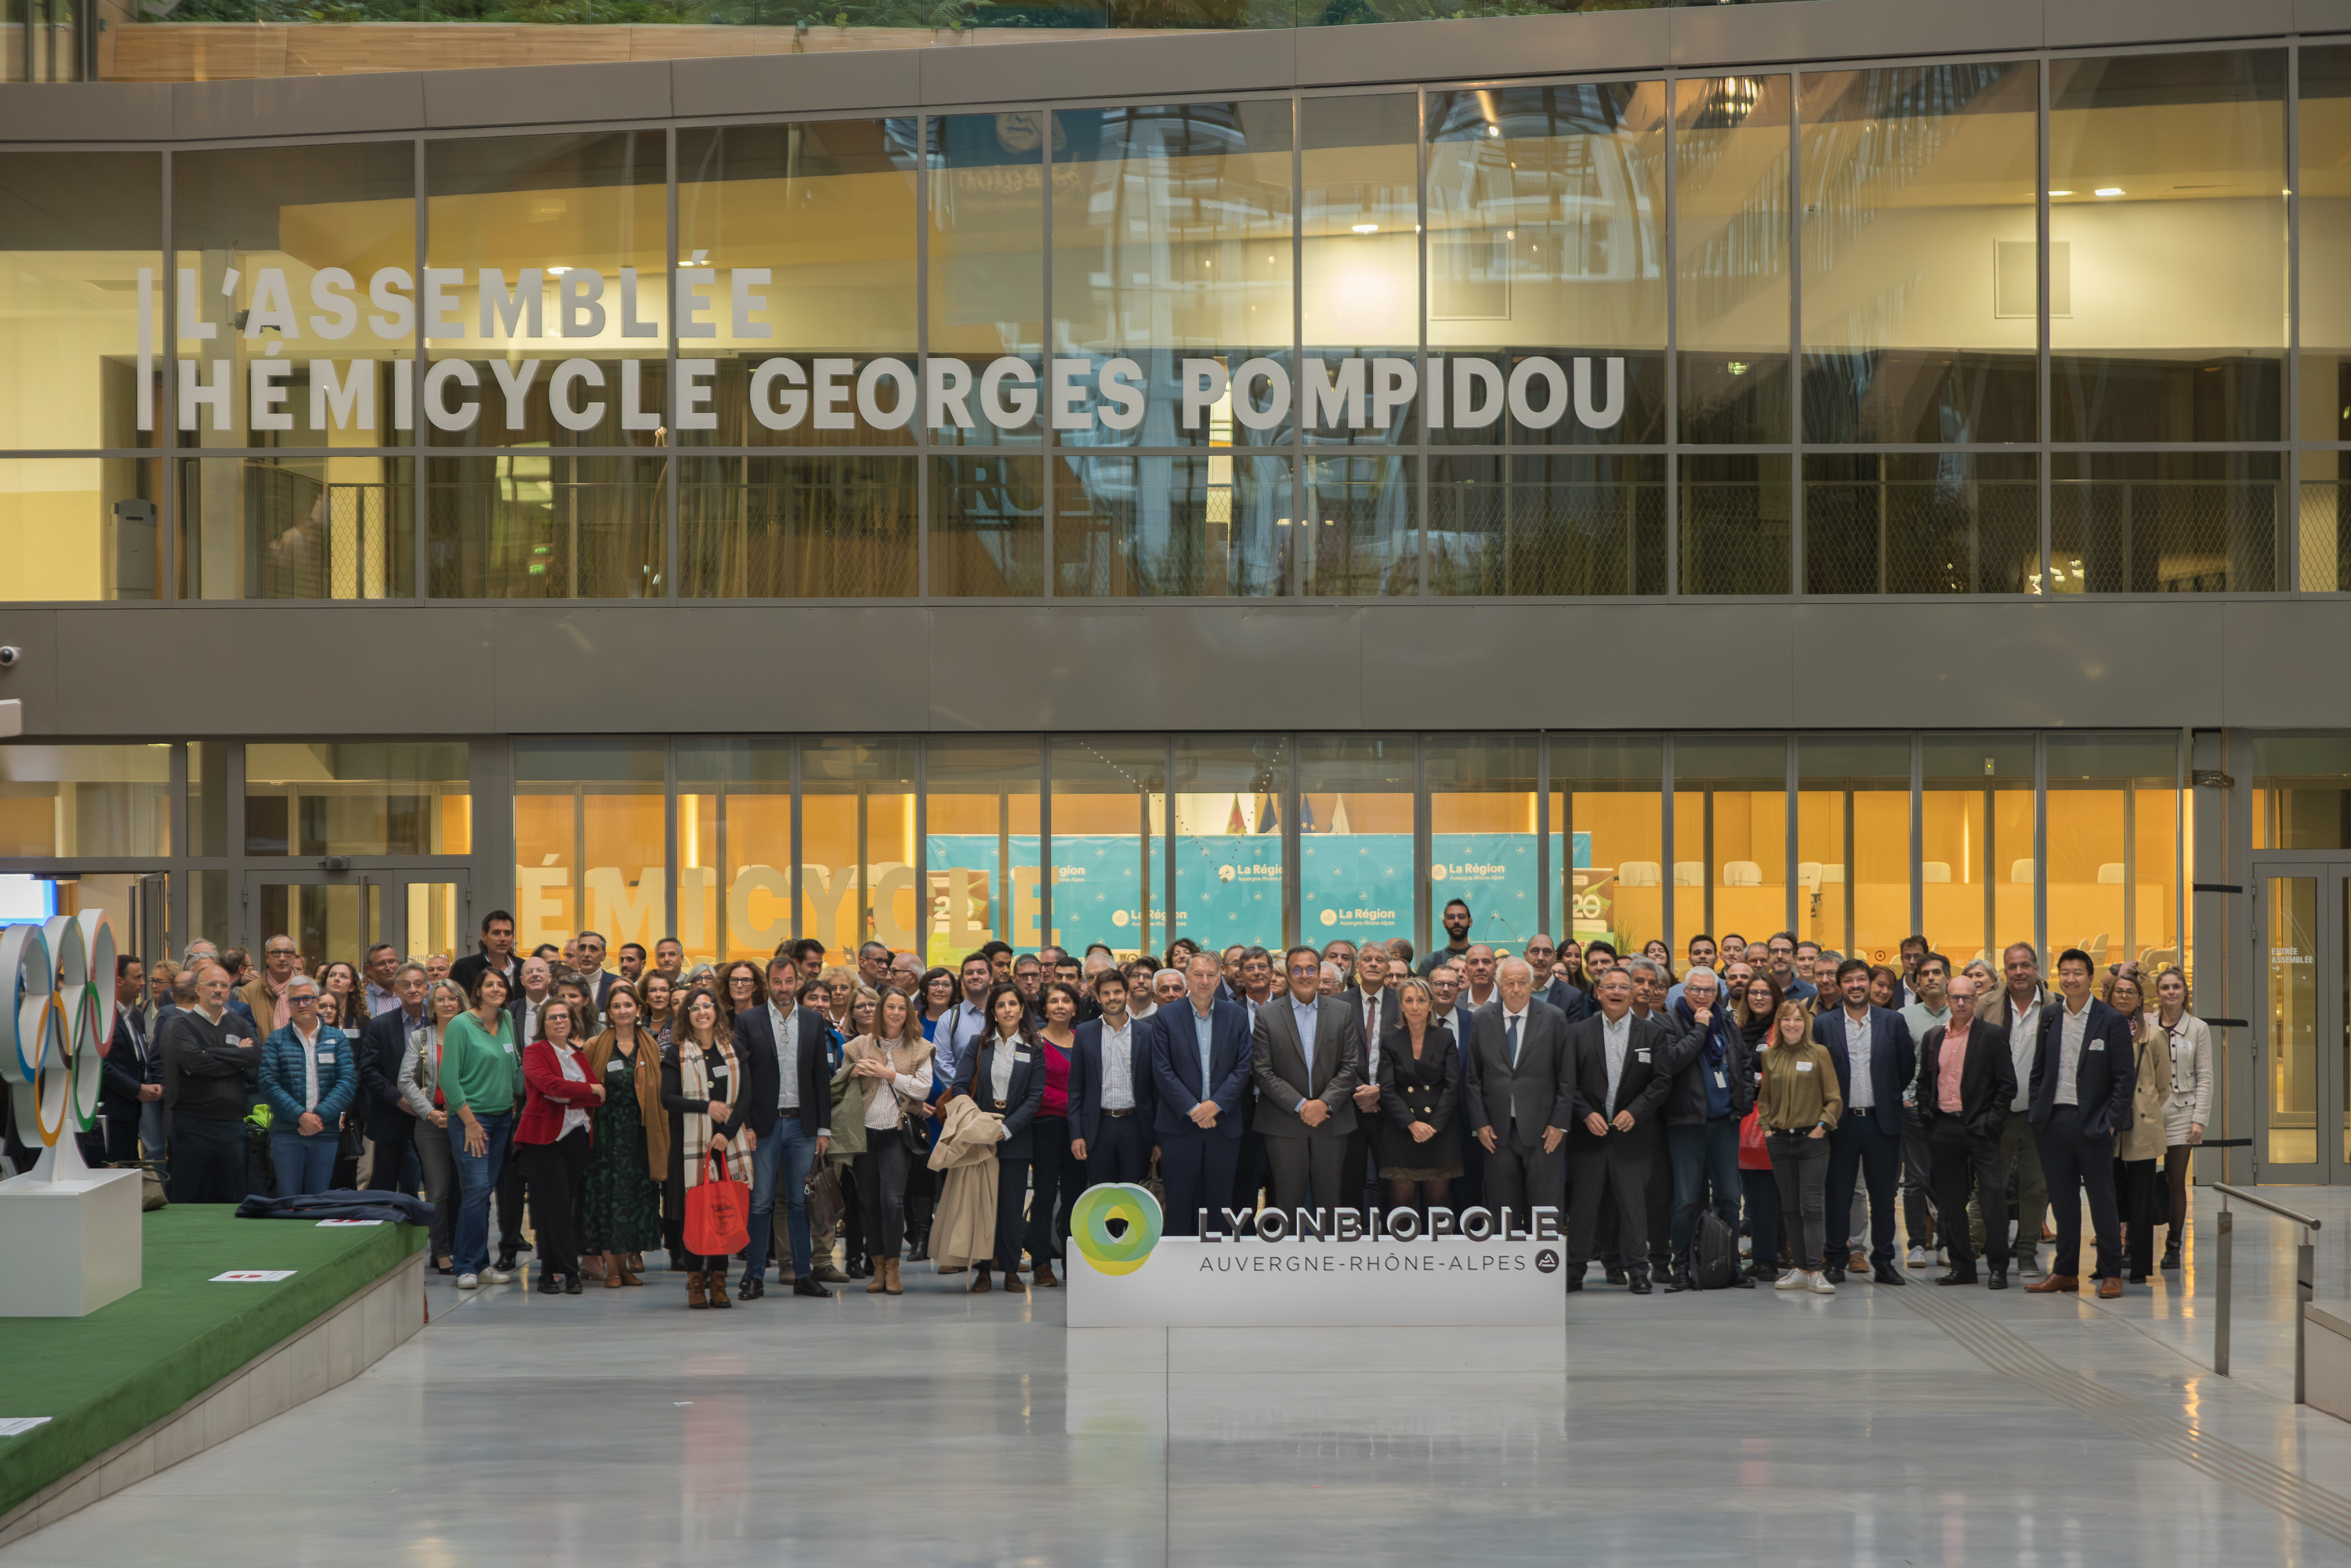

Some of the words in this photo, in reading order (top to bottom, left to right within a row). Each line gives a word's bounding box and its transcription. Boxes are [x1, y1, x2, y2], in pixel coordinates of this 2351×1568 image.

[177, 250, 773, 339] L'ASSEMBLÉE
[177, 341, 718, 431] HÉMICYCLE
[749, 356, 1146, 431] GEORGES
[1182, 355, 1625, 430] POMPIDOU
[1055, 865, 1085, 877] gion
[1237, 864, 1251, 875] La
[1253, 864, 1283, 876] Régio
[1449, 864, 1462, 874] La
[1465, 863, 1505, 875] Région
[521, 853, 1061, 950] ÉMICYCLE
[1131, 909, 1142, 919] La
[1339, 909, 1353, 919] La
[1355, 908, 1395, 921] Région
[2271, 947, 2298, 955] ENTRÉE
[2271, 954, 2313, 964] ASSEMBLÉE
[1199, 1206, 1559, 1243] LYONBIOPOLE
[1199, 1253, 1526, 1272] AUVERGNE-RHÔNE-ALPES
